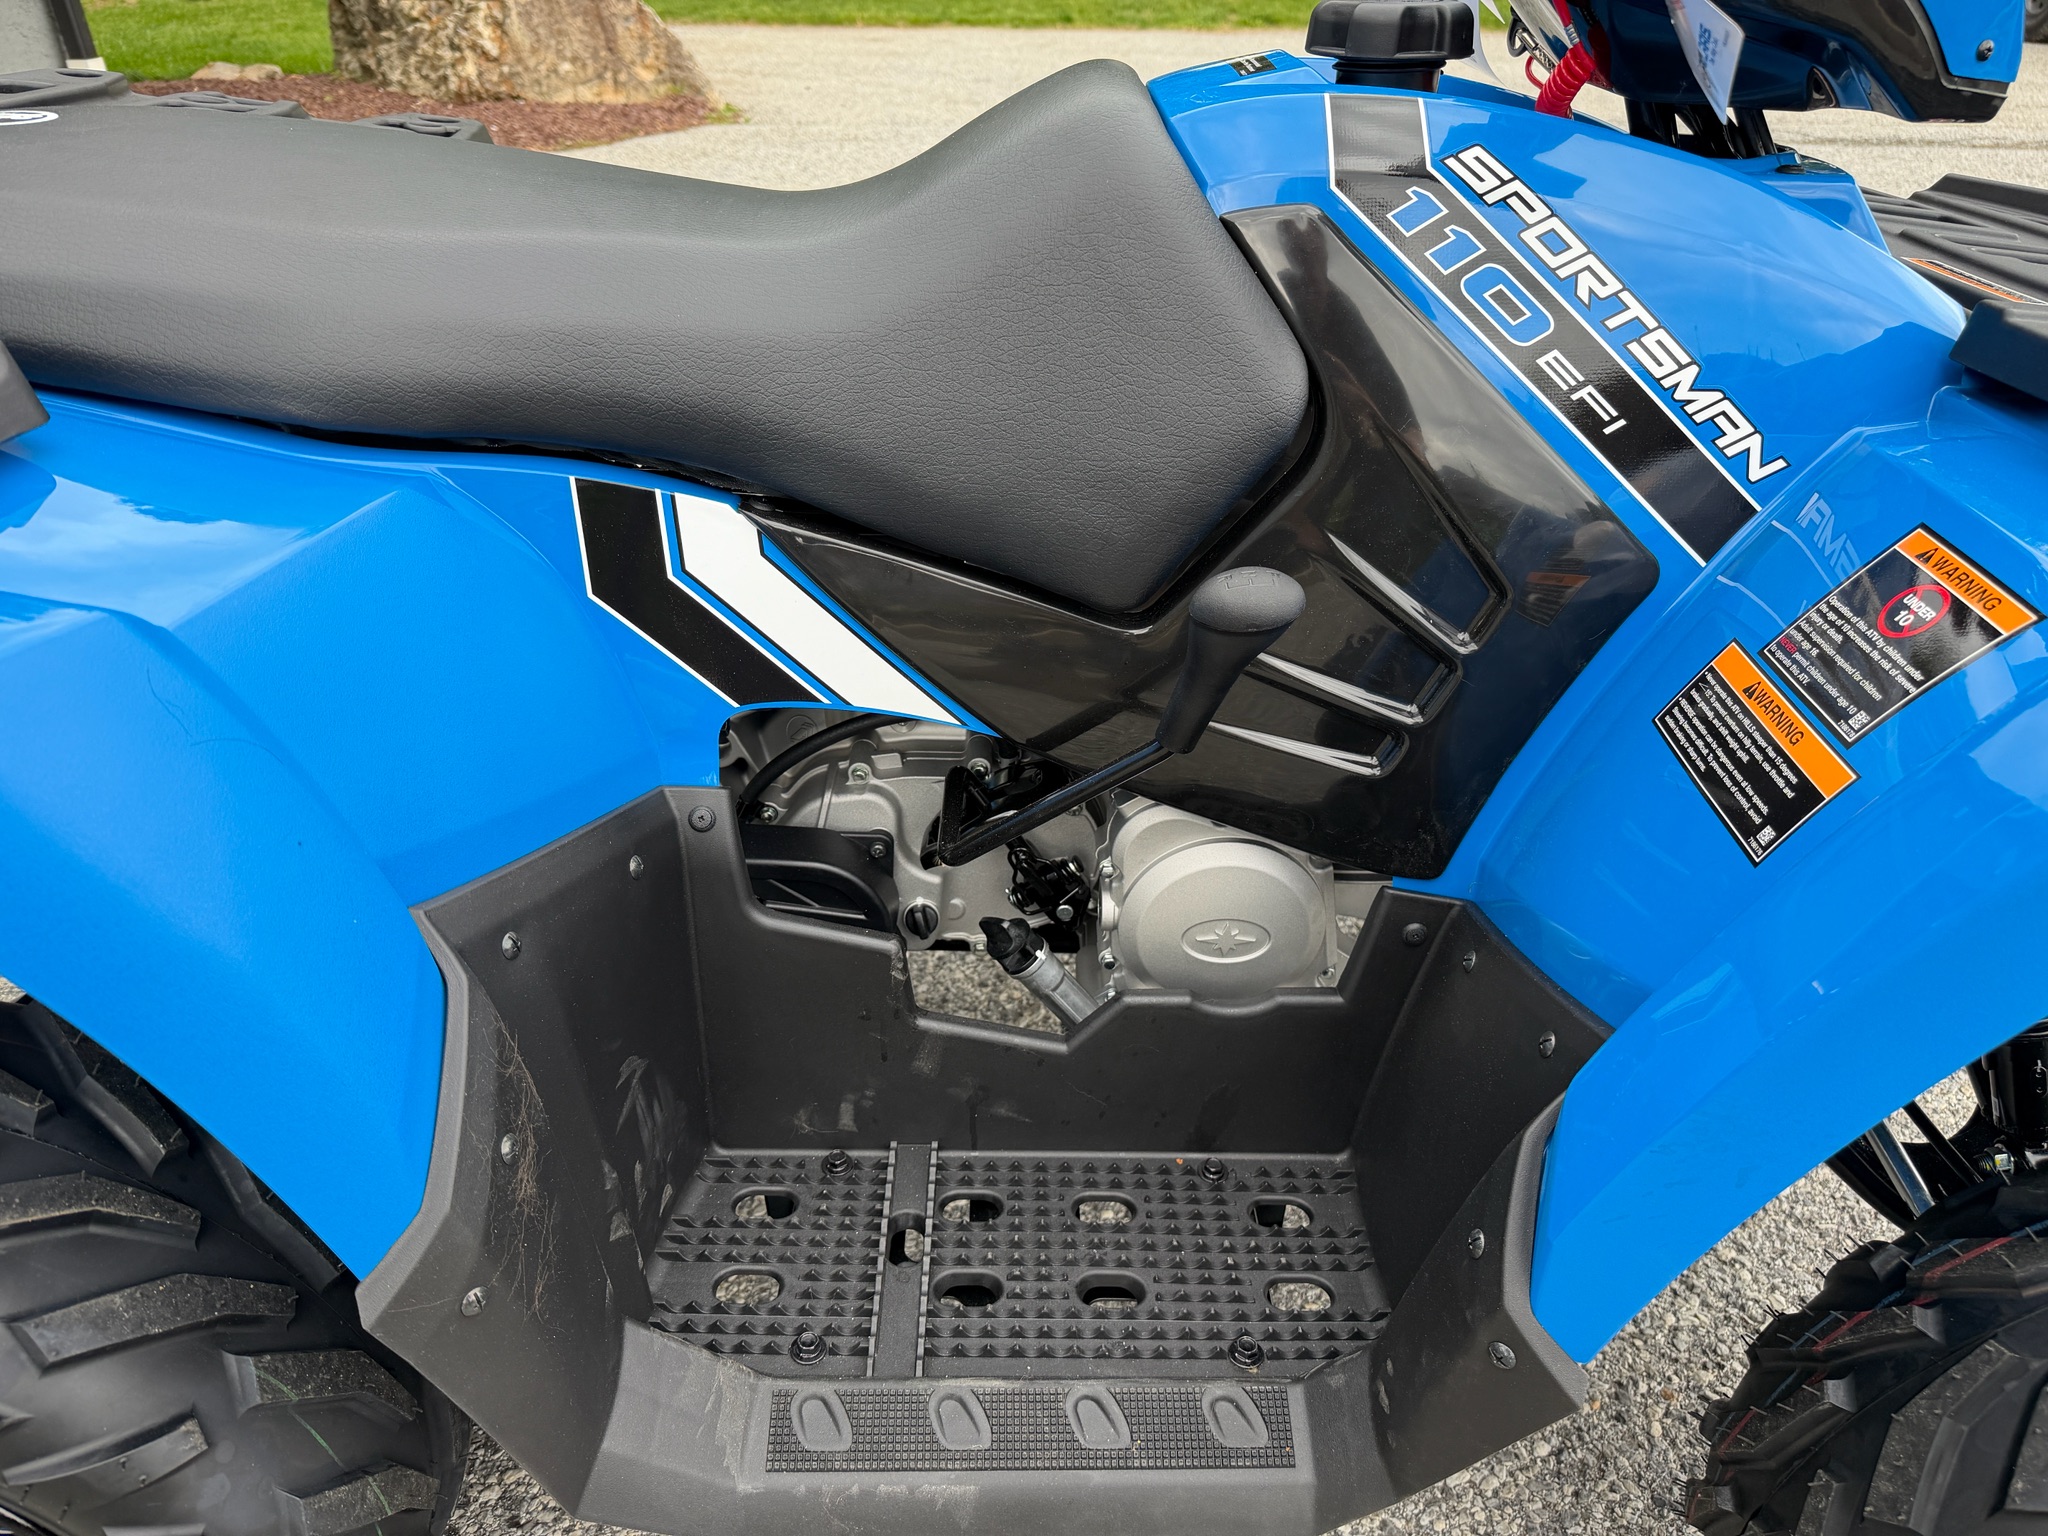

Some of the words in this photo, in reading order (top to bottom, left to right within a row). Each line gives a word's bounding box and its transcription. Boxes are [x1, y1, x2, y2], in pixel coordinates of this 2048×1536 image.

[1386, 186, 1554, 346] 110
[1536, 350, 1627, 435] EFI
[1444, 145, 1789, 483] SPORTSMAN
[1818, 602, 1831, 613] the
[1901, 593, 1937, 622] UNDER
[1929, 555, 2004, 612] WARNING
[1788, 627, 1805, 642] under
[1799, 639, 1813, 651] age
[1808, 646, 1821, 657] 16.
[1807, 610, 1826, 626] injury
[1825, 626, 1846, 644] death.
[1824, 610, 1838, 622] age
[1826, 594, 1855, 620] Operation
[1855, 619, 1870, 632] this
[1864, 628, 1881, 642] ATV
[1881, 643, 1909, 667] children
[1903, 663, 1925, 682] under
[1845, 628, 1874, 653] increases
[1891, 608, 1916, 628] 10
[1772, 648, 1793, 668] operate
[1788, 663, 1802, 676] this
[1796, 672, 1811, 686] ATV.
[1778, 635, 1798, 654] NEVER
[1791, 650, 1811, 668] permit
[1805, 663, 1828, 685] children
[1822, 680, 1841, 698] under
[1833, 695, 1849, 709] age
[1798, 619, 1813, 633] Adult
[1807, 629, 1838, 657] supervision
[1831, 652, 1856, 675] required
[1851, 670, 1864, 682] for
[1858, 677, 1884, 701] children
[1868, 649, 1882, 661] the
[1877, 657, 1893, 671] risk
[1893, 673, 1917, 694] severe
[1664, 713, 1677, 730] sudden
[1671, 726, 1687, 745] braking
[1685, 744, 1699, 761] sharp
[1694, 756, 1707, 773] turns.
[1689, 687, 1703, 703] brakes
[1712, 716, 1722, 728] and
[1717, 724, 1729, 737] shift
[1723, 733, 1740, 752] weight
[1734, 746, 1751, 765] uphill.
[1705, 672, 1717, 686] Never
[1711, 682, 1728, 701] operate
[1724, 695, 1734, 707] this
[1730, 703, 1741, 715] ATV
[1741, 716, 1756, 733] HILLS
[1750, 729, 1769, 750] steeper
[1764, 745, 1778, 759] than
[1777, 761, 1799, 786] degrees
[1752, 688, 1806, 747] WARNING
[1670, 705, 1687, 725] Steering
[1681, 720, 1698, 741] becomes
[1708, 758, 1726, 780] prevent
[1722, 774, 1734, 788] loss
[1733, 789, 1752, 811] control,
[1747, 806, 1763, 825] avoid
[1679, 697, 1696, 719] REVERSE
[1689, 714, 1709, 738] operation
[1704, 733, 1713, 744] can
[1713, 745, 1736, 773] dangerous
[1731, 768, 1743, 783] even
[1744, 784, 1755, 796] low
[1750, 792, 1771, 817] speeds.
[1711, 699, 1728, 718] prevent
[1723, 713, 1741, 733] overturn
[1740, 735, 1753, 749] hilly
[1747, 744, 1765, 764] terrain,
[1761, 760, 1772, 772] use
[1768, 768, 1787, 789] throttle
[1782, 784, 1795, 799] and
